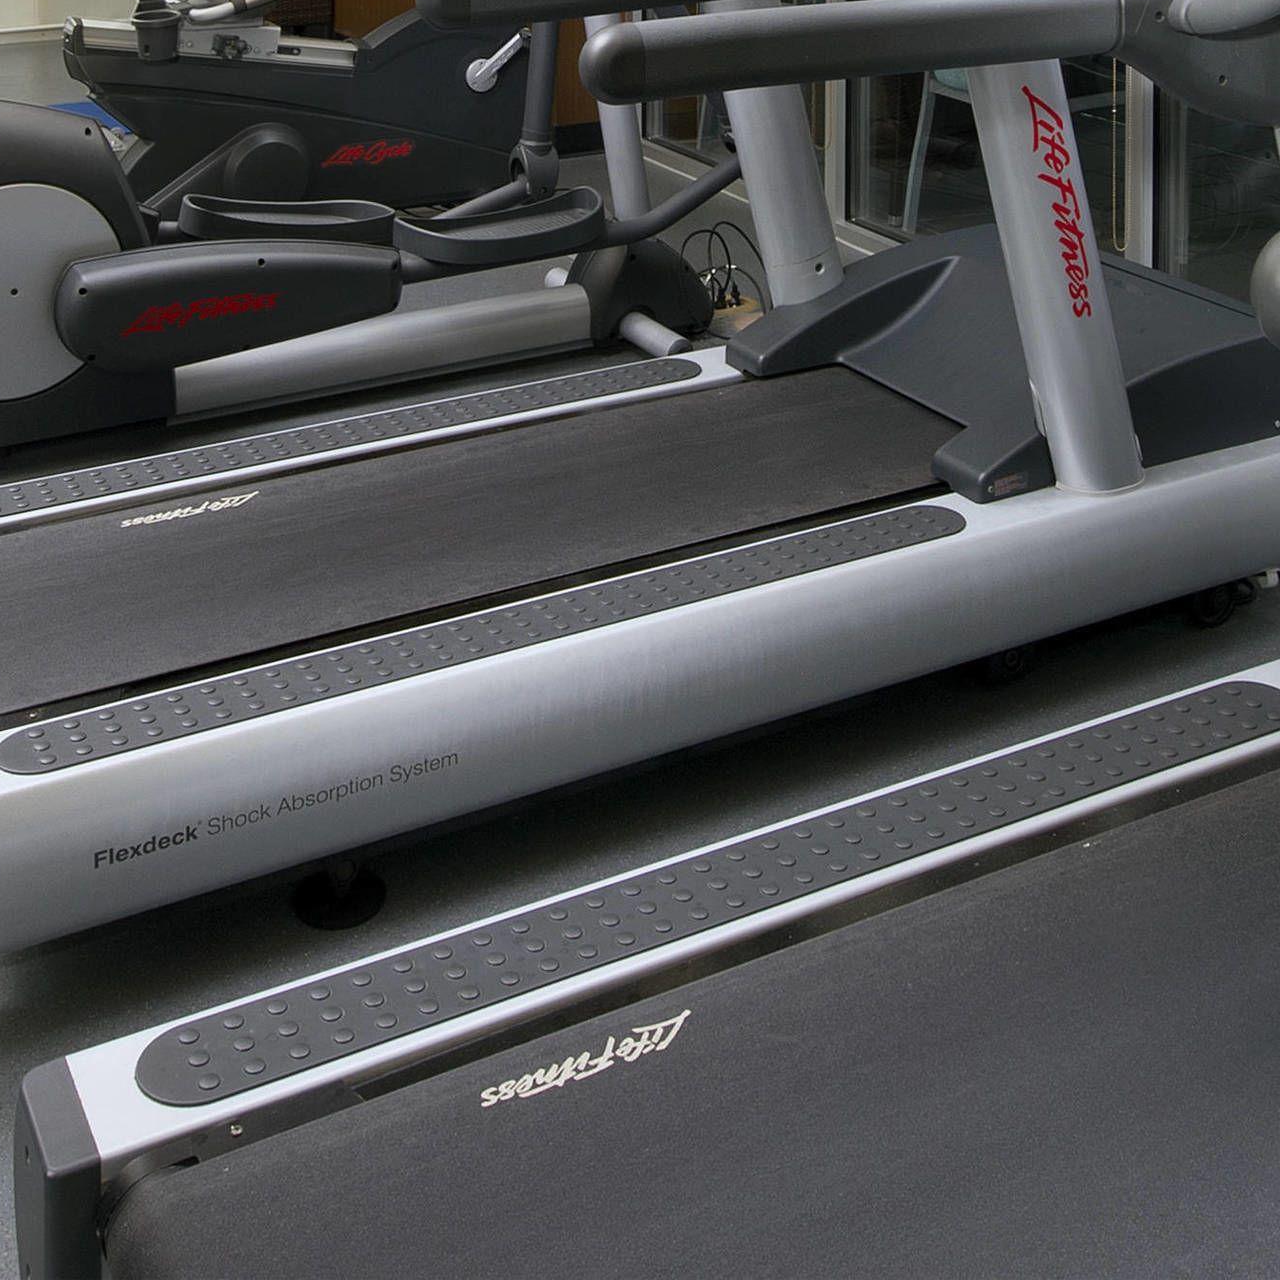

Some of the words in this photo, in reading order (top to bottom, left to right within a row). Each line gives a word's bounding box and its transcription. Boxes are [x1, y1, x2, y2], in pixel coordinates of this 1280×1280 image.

[207, 804, 271, 836] Shock
[276, 772, 384, 817] Absorption
[389, 750, 460, 784] System
